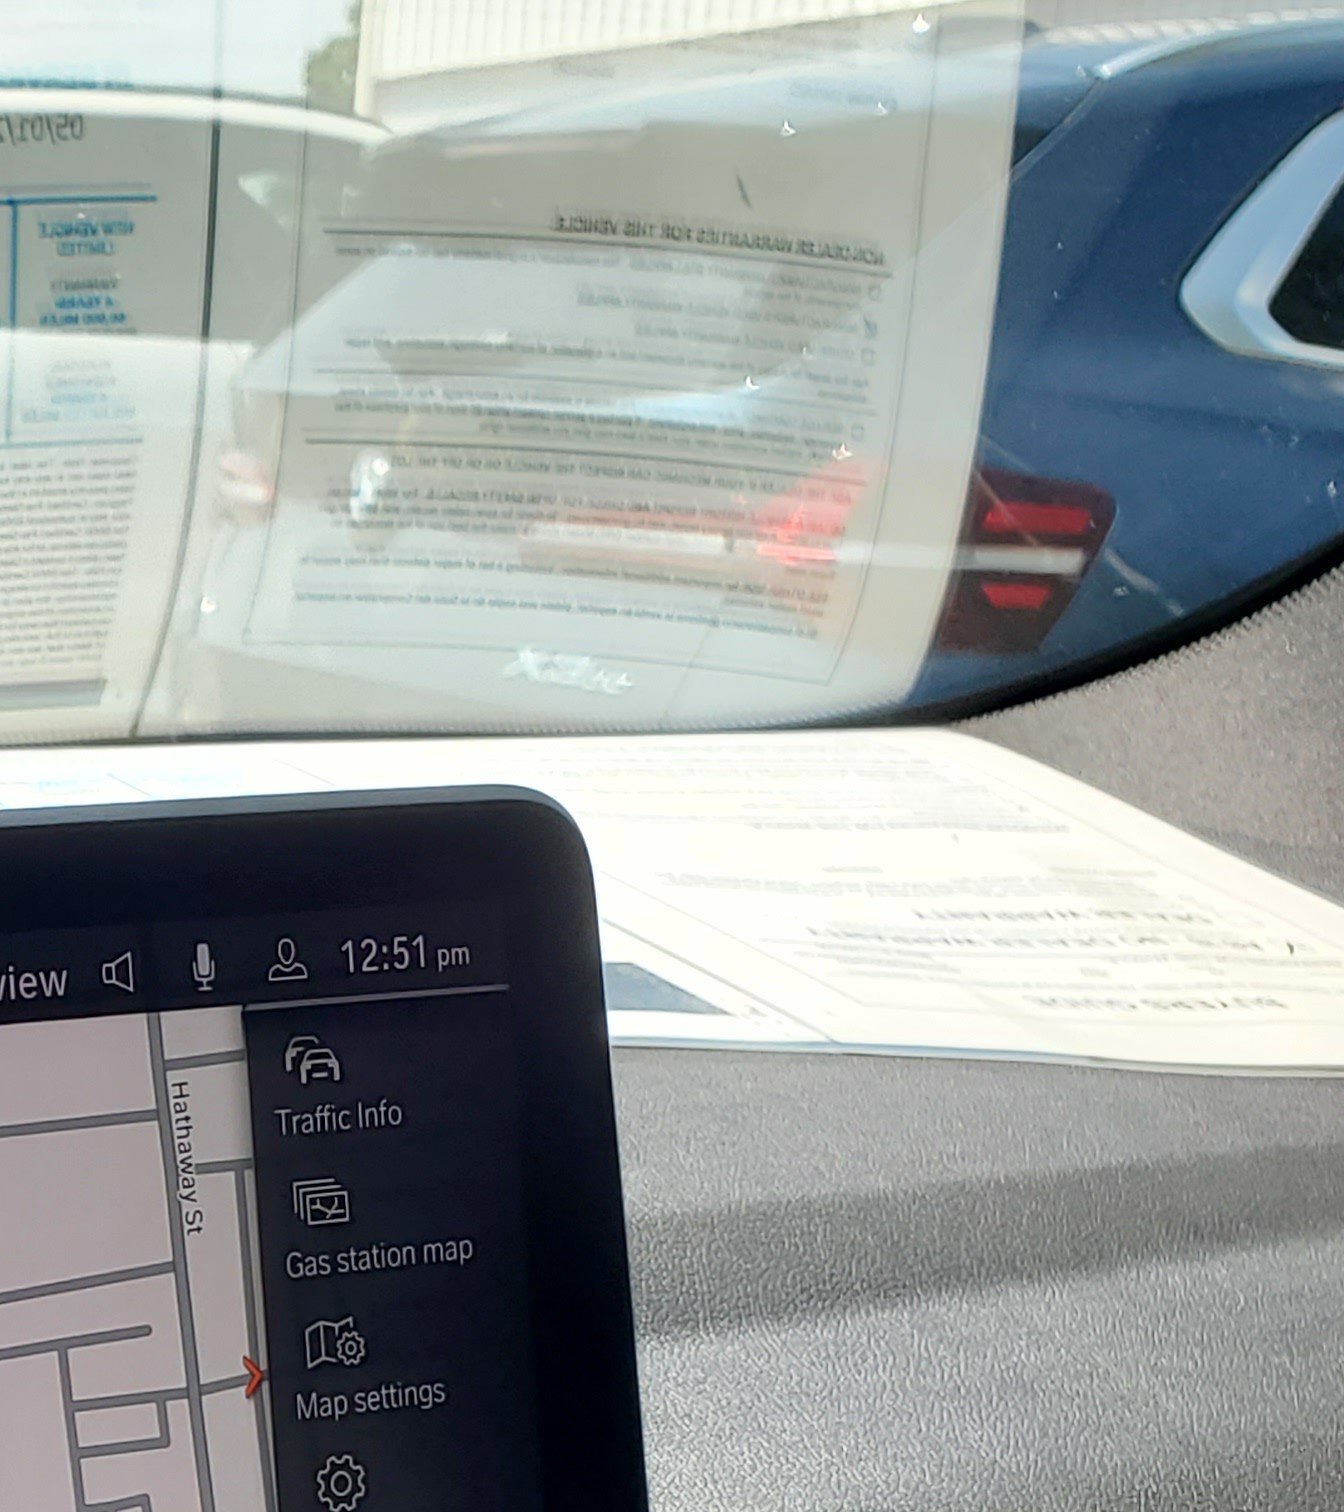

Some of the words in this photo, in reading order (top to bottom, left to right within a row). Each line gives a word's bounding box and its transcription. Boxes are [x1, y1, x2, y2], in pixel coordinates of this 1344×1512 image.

[339, 936, 428, 976] 12:51
[436, 945, 471, 972] pm
[273, 1105, 352, 1137] Traffic
[357, 1099, 403, 1129] Info
[170, 1080, 199, 1203] Hathaway
[183, 1209, 204, 1236] St
[285, 1251, 331, 1280] Gas
[335, 1243, 417, 1274] station
[423, 1238, 474, 1267] map
[295, 1393, 349, 1422] Map
[354, 1381, 447, 1412] settings
